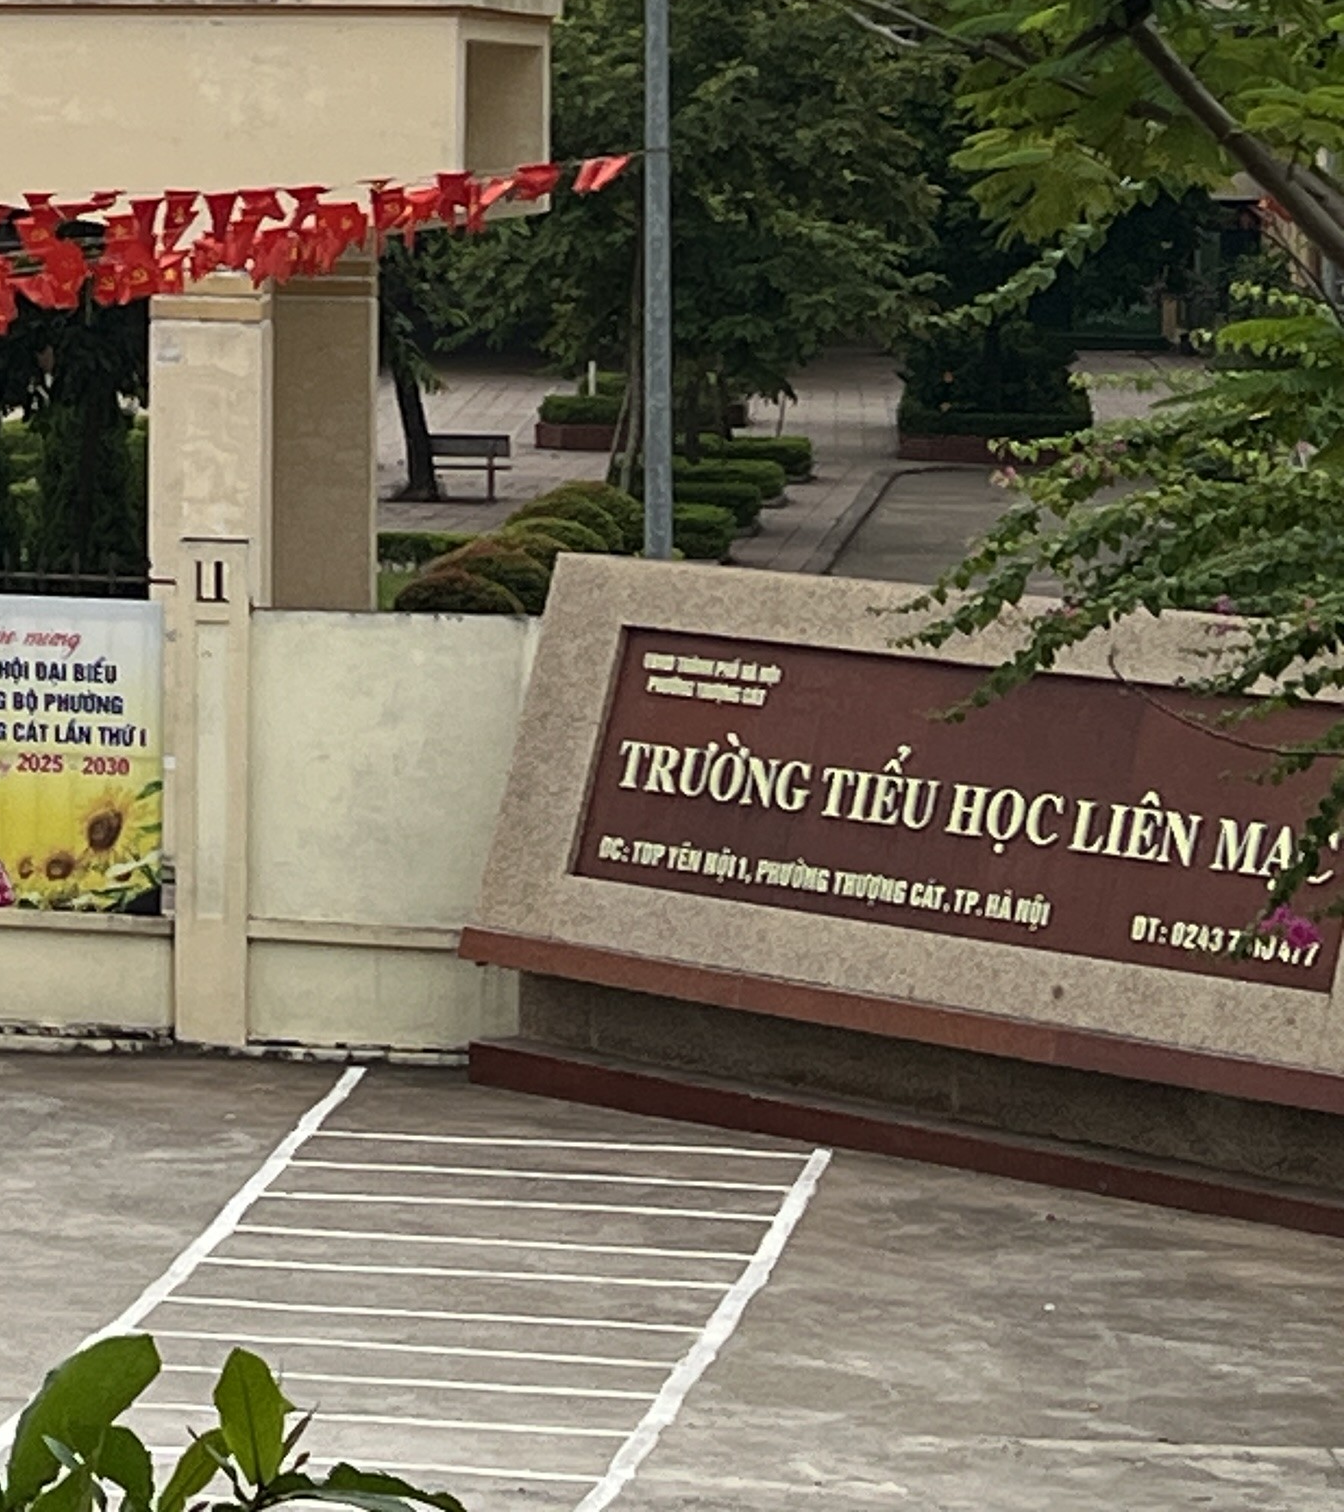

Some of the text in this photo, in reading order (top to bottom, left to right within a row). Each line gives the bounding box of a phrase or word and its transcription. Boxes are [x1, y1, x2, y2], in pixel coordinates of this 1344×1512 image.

[73, 655, 117, 684] BIỂU
[12, 688, 39, 715] BỘ
[44, 689, 124, 715] PHƯỜNG
[13, 719, 49, 743] CÁT
[98, 723, 137, 747] THỨ
[16, 752, 64, 774] 2025
[81, 755, 131, 776] 2030
[618, 732, 812, 812] TRƯỜNG
[820, 744, 941, 830] TIỂU
[943, 782, 1065, 854] HỌC
[1066, 789, 1204, 868] LIÊN
[666, 841, 703, 874] YÊN
[703, 846, 737, 884] NỘI
[755, 856, 831, 894] PHƯỜNG
[833, 870, 908, 907] THƯỢNG
[953, 888, 983, 917] TP.
[984, 888, 1013, 921] HÀ
[1015, 893, 1052, 932] NỘI
[1170, 921, 1224, 952] 0243
